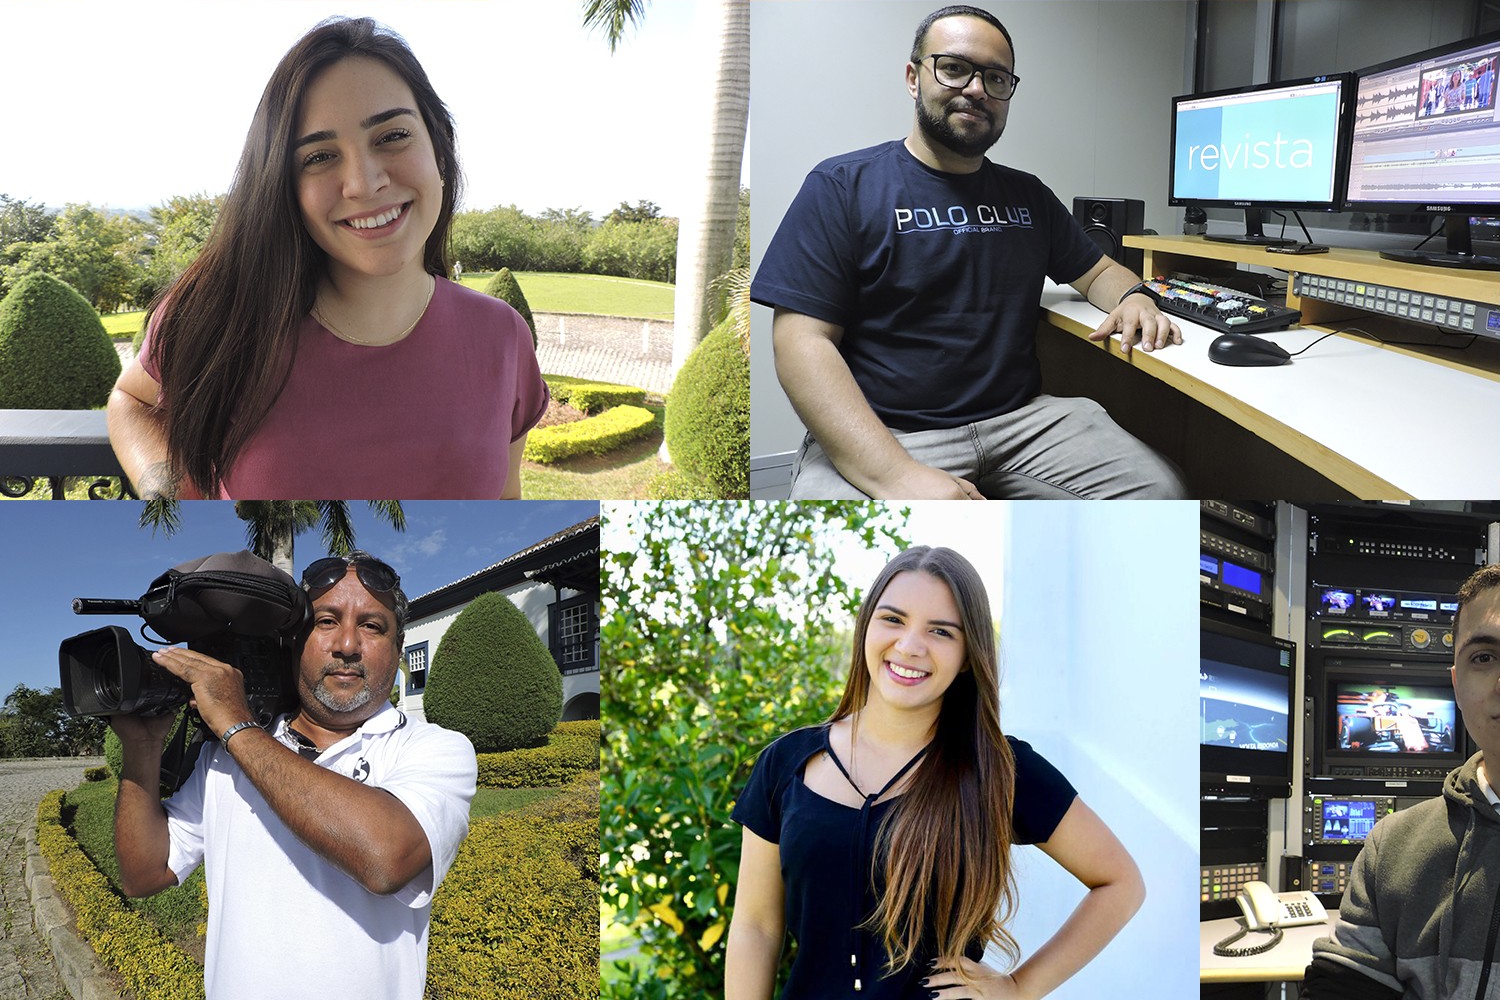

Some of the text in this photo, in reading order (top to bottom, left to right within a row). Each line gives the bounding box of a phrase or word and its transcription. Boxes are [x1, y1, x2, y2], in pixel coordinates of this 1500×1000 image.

[1188, 131, 1313, 171] revista
[894, 204, 1033, 230] POLO CLUB
